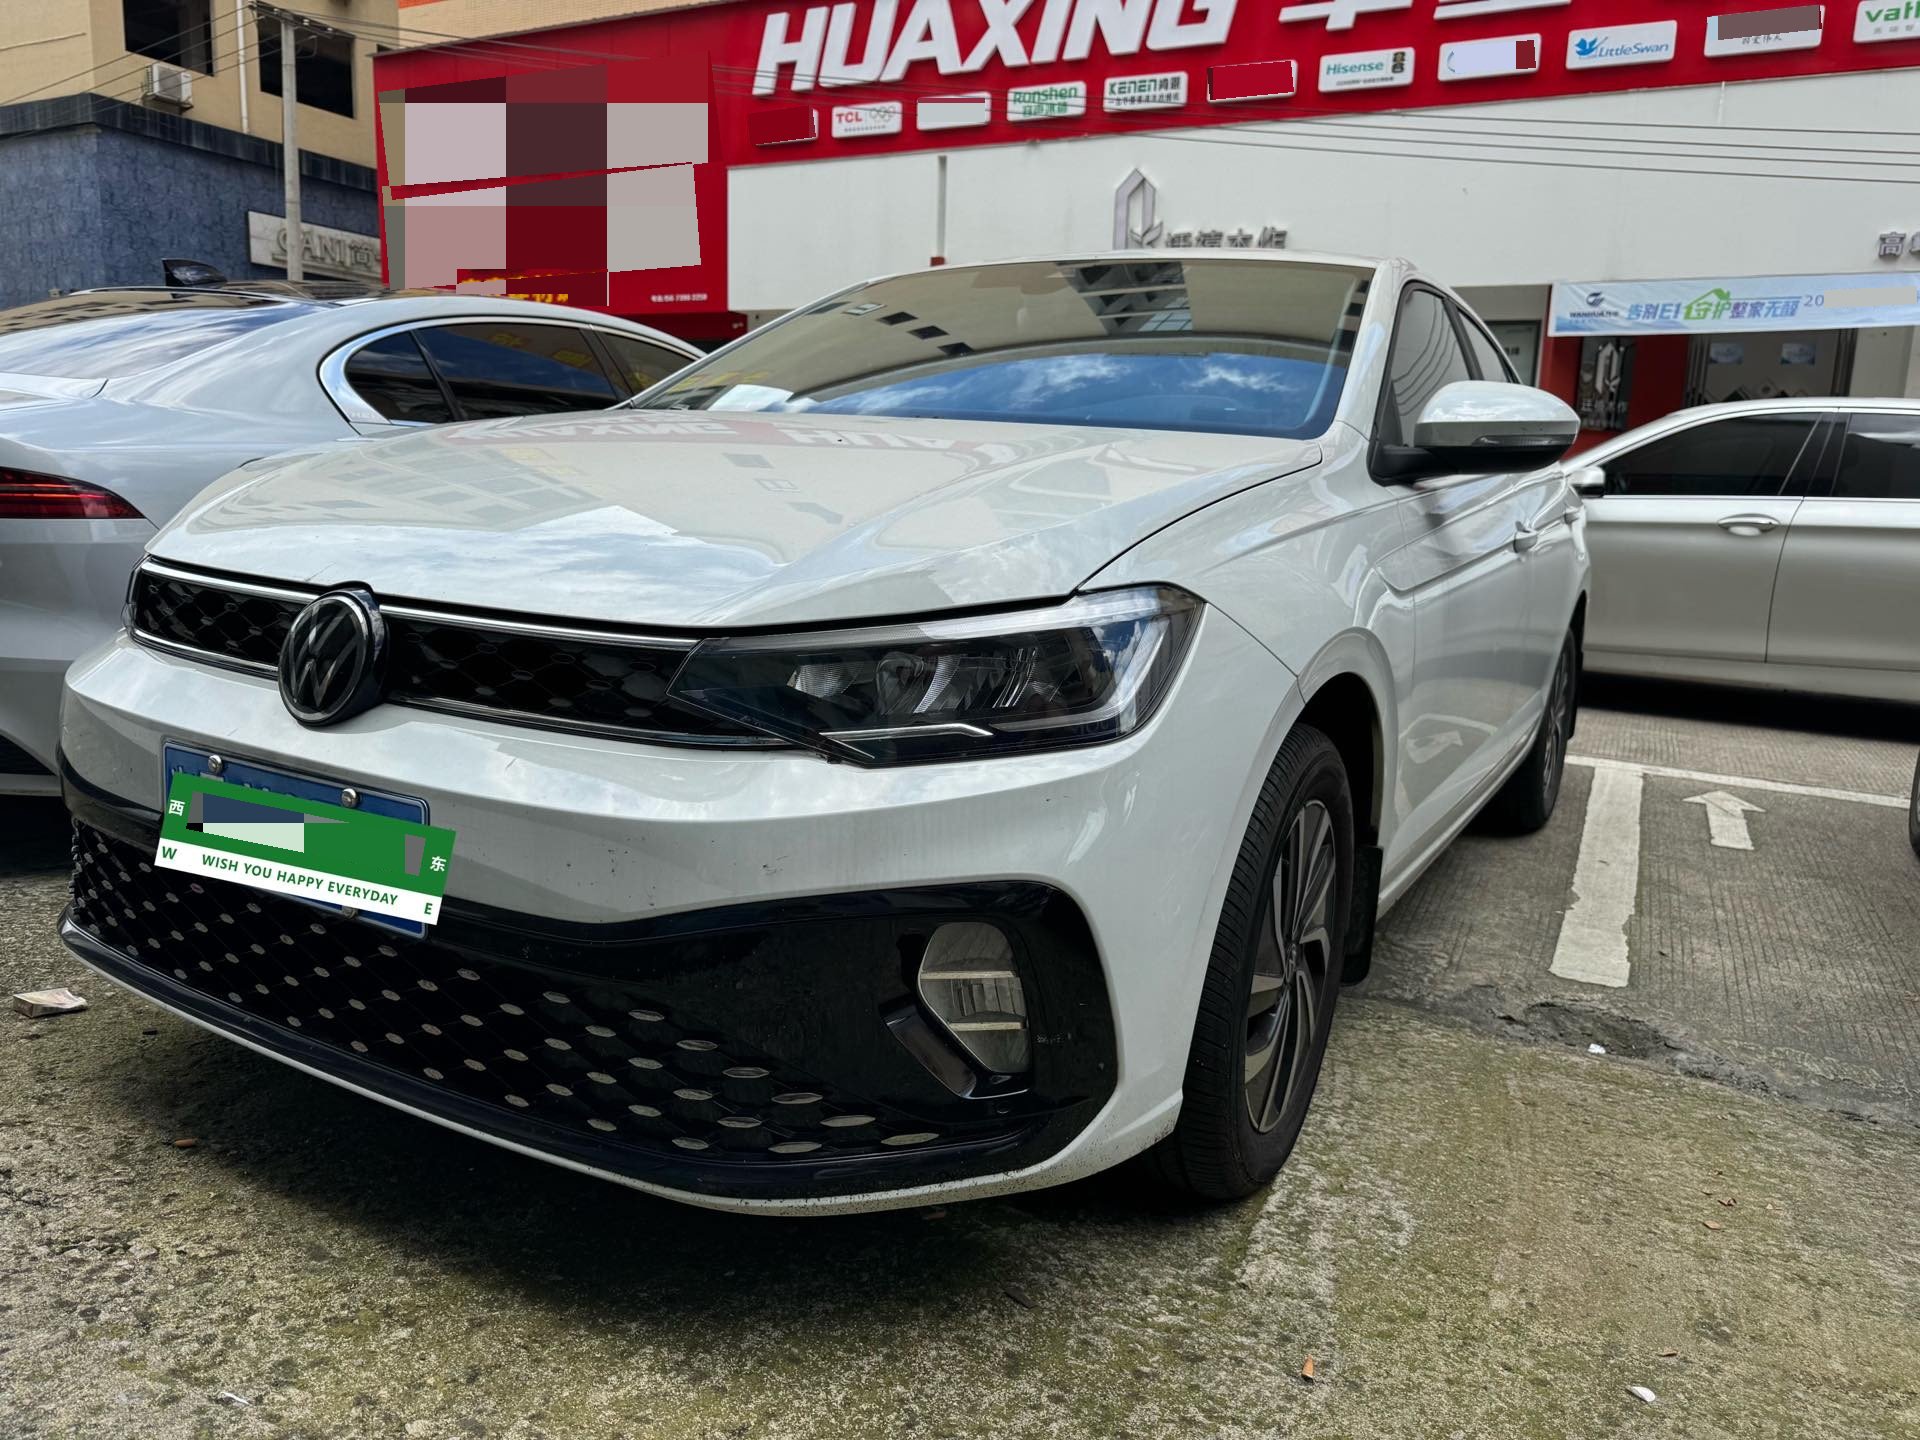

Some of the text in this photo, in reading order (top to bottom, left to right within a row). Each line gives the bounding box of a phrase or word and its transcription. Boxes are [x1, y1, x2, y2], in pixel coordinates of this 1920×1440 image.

[752, 0, 1234, 96] HUAXING
[1599, 43, 1669, 57] LittleSwan
[1326, 62, 1384, 75] Hisense
[1013, 87, 1077, 104] Ronshen
[836, 112, 862, 124] TCL
